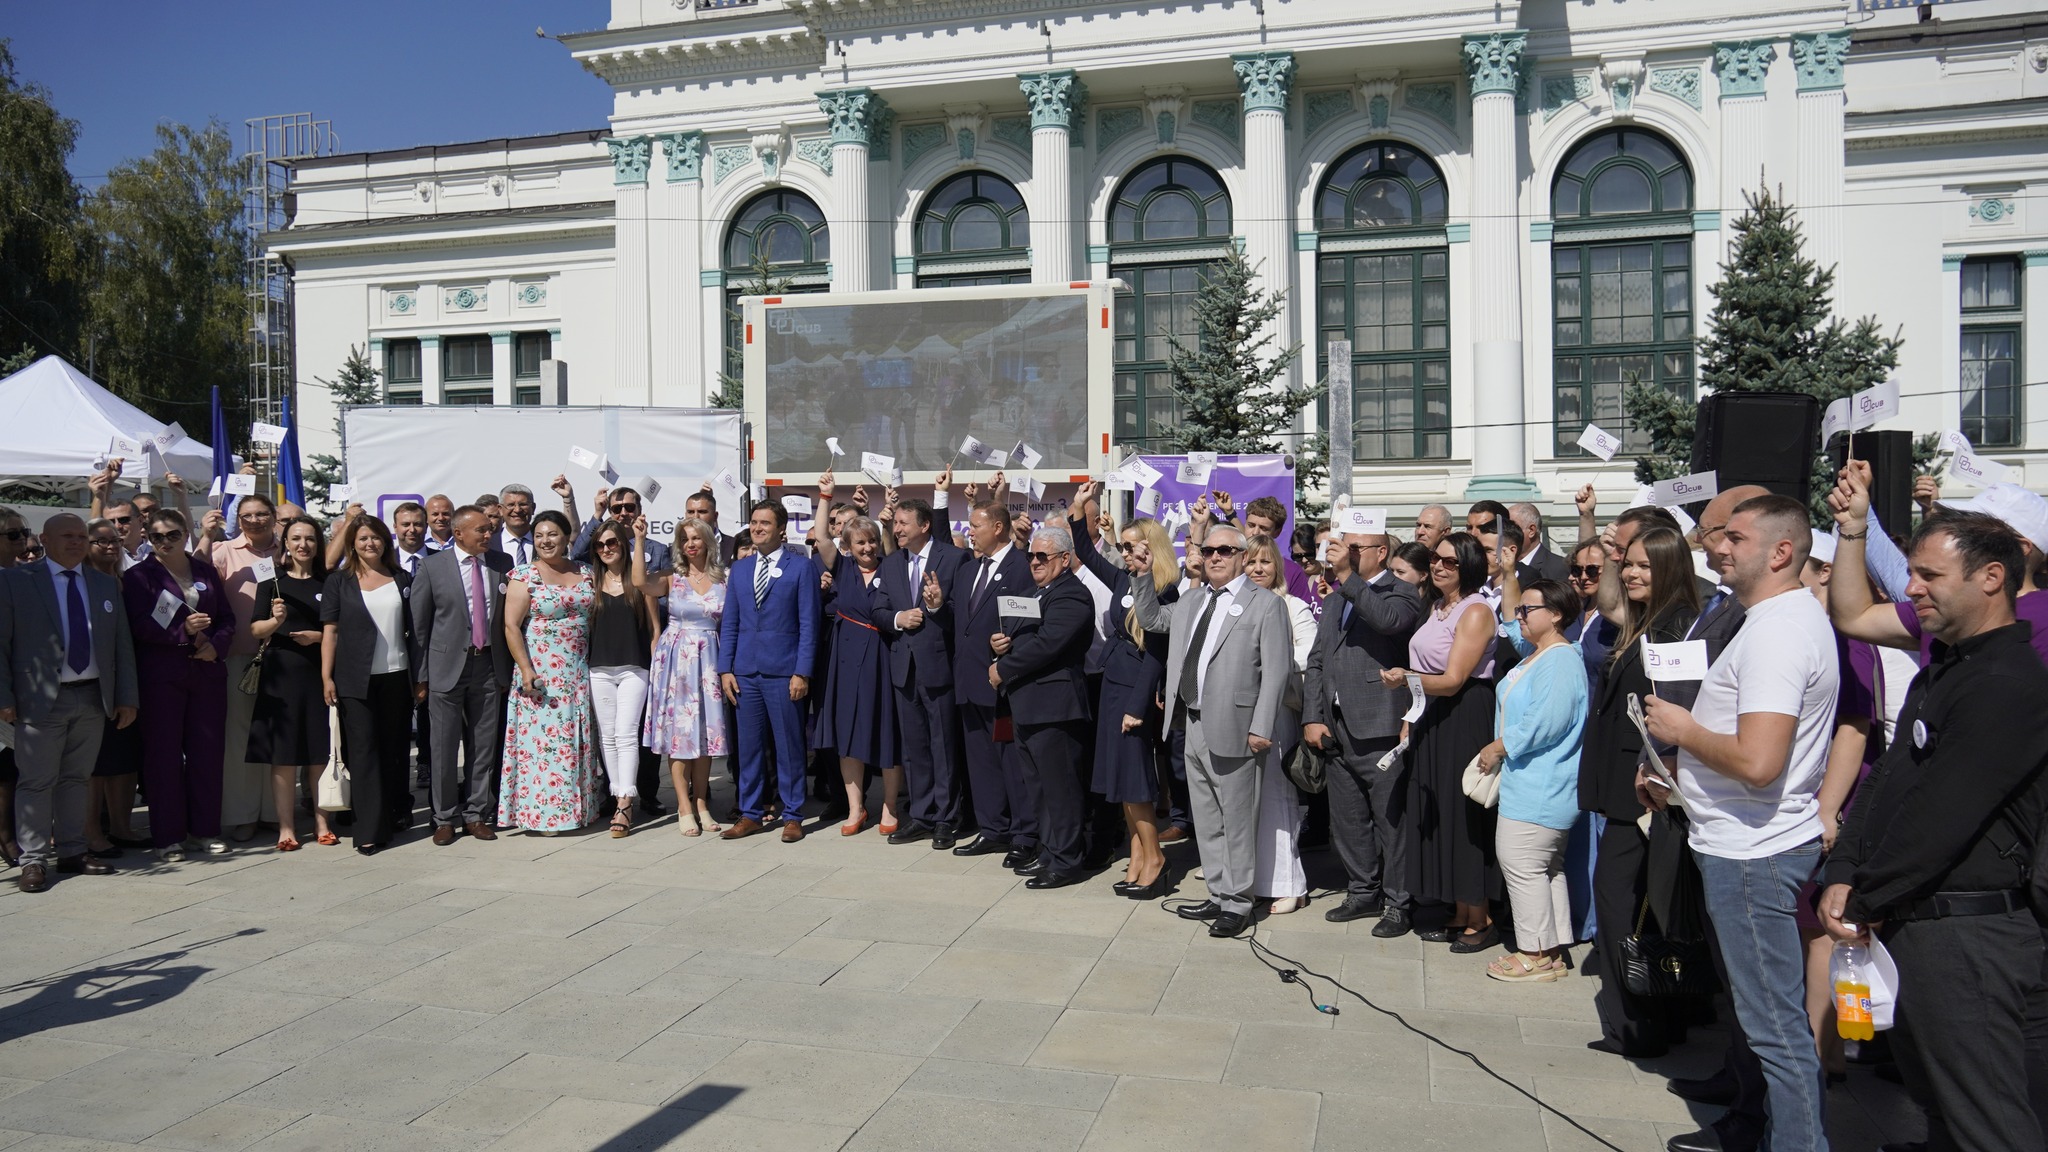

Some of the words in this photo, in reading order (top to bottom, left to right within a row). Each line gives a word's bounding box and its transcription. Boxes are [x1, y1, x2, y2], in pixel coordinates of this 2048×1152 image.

[796, 323, 822, 334] CUB
[1871, 400, 1884, 410] CUB
[1968, 466, 1983, 477] CUB
[1667, 658, 1681, 666] UB
